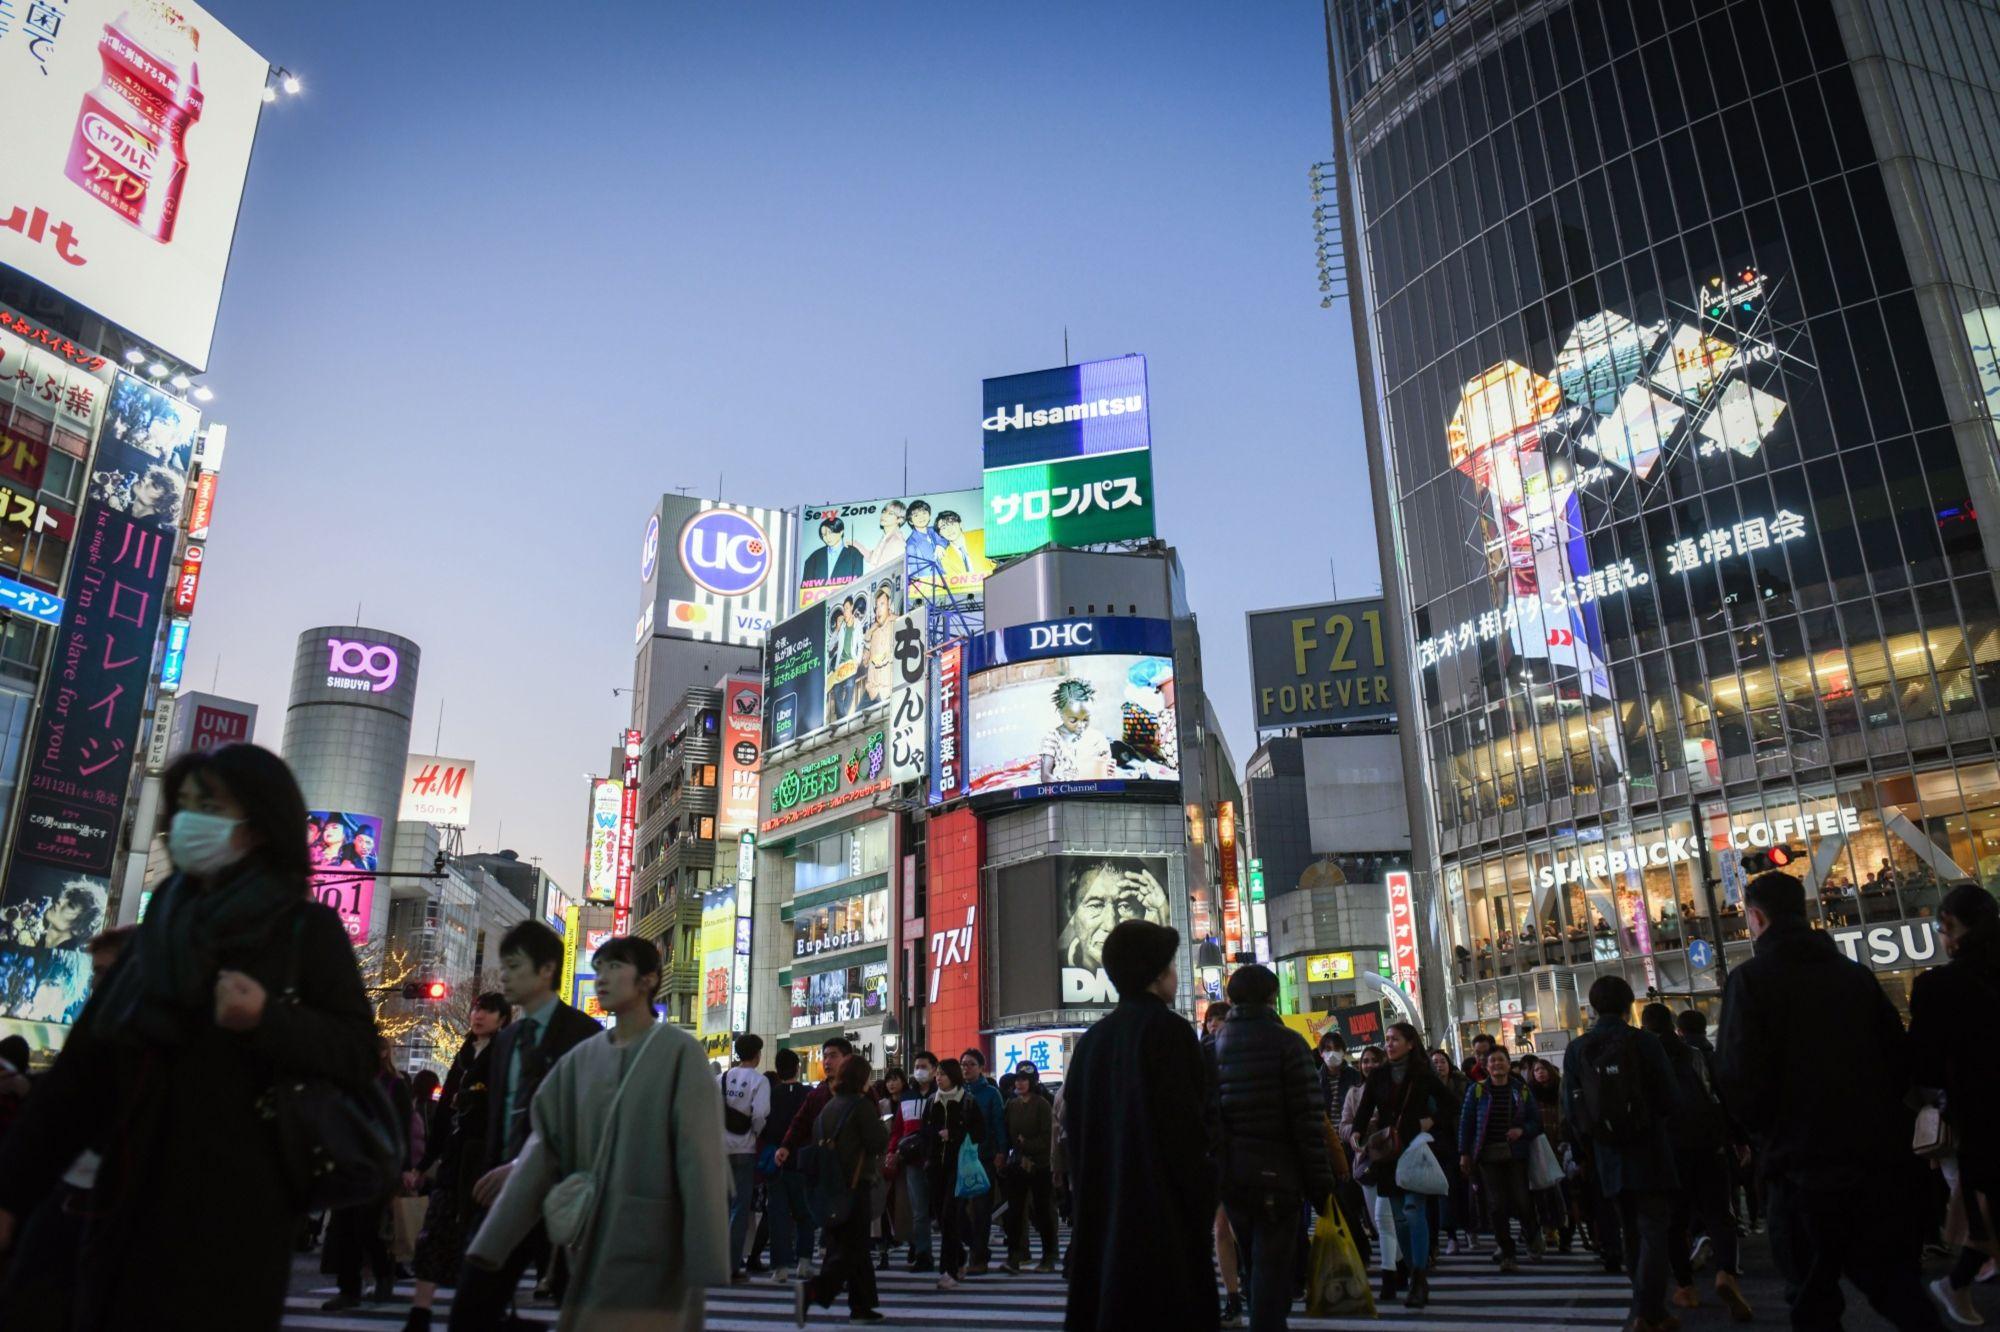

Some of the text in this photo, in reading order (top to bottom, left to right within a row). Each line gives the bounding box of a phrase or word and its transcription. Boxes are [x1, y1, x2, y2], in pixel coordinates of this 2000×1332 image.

[96, 124, 152, 170] ヤクルト
[82, 147, 150, 200] ファイブ
[982, 394, 1142, 432] Hisamitsu
[804, 504, 877, 522] Sexy Zone
[991, 476, 1142, 525] サロンパス
[1666, 508, 1806, 575] 通常国会
[0, 581, 59, 616] ーオン
[801, 577, 826, 588] NEW
[737, 615, 772, 631] VISA
[1030, 622, 1092, 650] DHC
[80, 522, 163, 777] 川口レイジ
[1292, 610, 1385, 676] F21
[327, 639, 399, 692] 109
[327, 676, 370, 691] SHIBUYA
[892, 617, 925, 773] もんじゃ
[1262, 675, 1391, 716] FOREVER
[200, 712, 238, 736] UNI
[776, 708, 793, 721] Uber
[776, 719, 792, 733] Eats
[940, 653, 955, 792] 三千里薬品
[150, 703, 170, 764] 渋谷駅前ビル
[411, 763, 467, 800] H&M
[801, 765, 839, 802] 西村
[1037, 782, 1097, 796] DHC Channel
[415, 803, 446, 816] 150m
[1539, 835, 1708, 888] STARBUCKS
[1728, 806, 1861, 850] COFFEE
[797, 929, 861, 956] Euphoria
[706, 966, 729, 1008] 薬
[1004, 1040, 1064, 1073] 大盛
